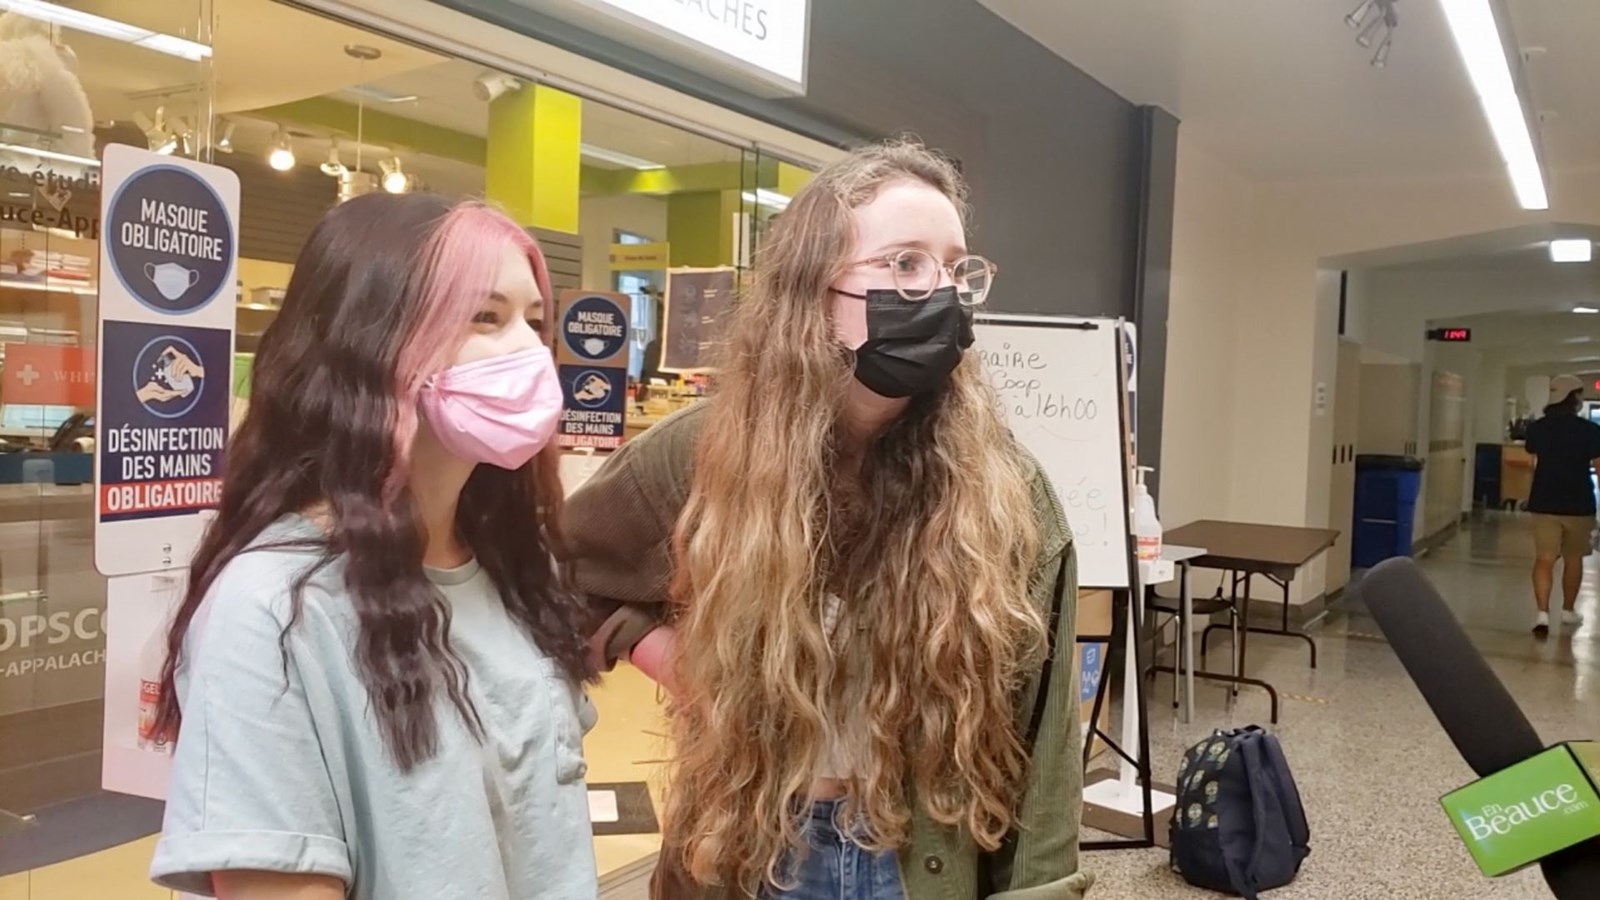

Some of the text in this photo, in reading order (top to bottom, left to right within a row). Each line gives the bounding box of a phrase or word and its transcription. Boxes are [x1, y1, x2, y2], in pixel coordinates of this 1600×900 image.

[141, 198, 208, 233] MASQUE
[121, 222, 223, 261] OBLIGATOIRE
[568, 322, 622, 337] OBLIGATOIRE
[577, 311, 614, 324] MASQUE
[108, 423, 223, 453] DÉSINFECTION
[566, 423, 614, 435] DES MAINS
[122, 454, 211, 480] DES MAINS
[107, 481, 222, 511] OBLIGATOIRE
[1465, 784, 1577, 841] Beauce
[1482, 803, 1503, 817] En
